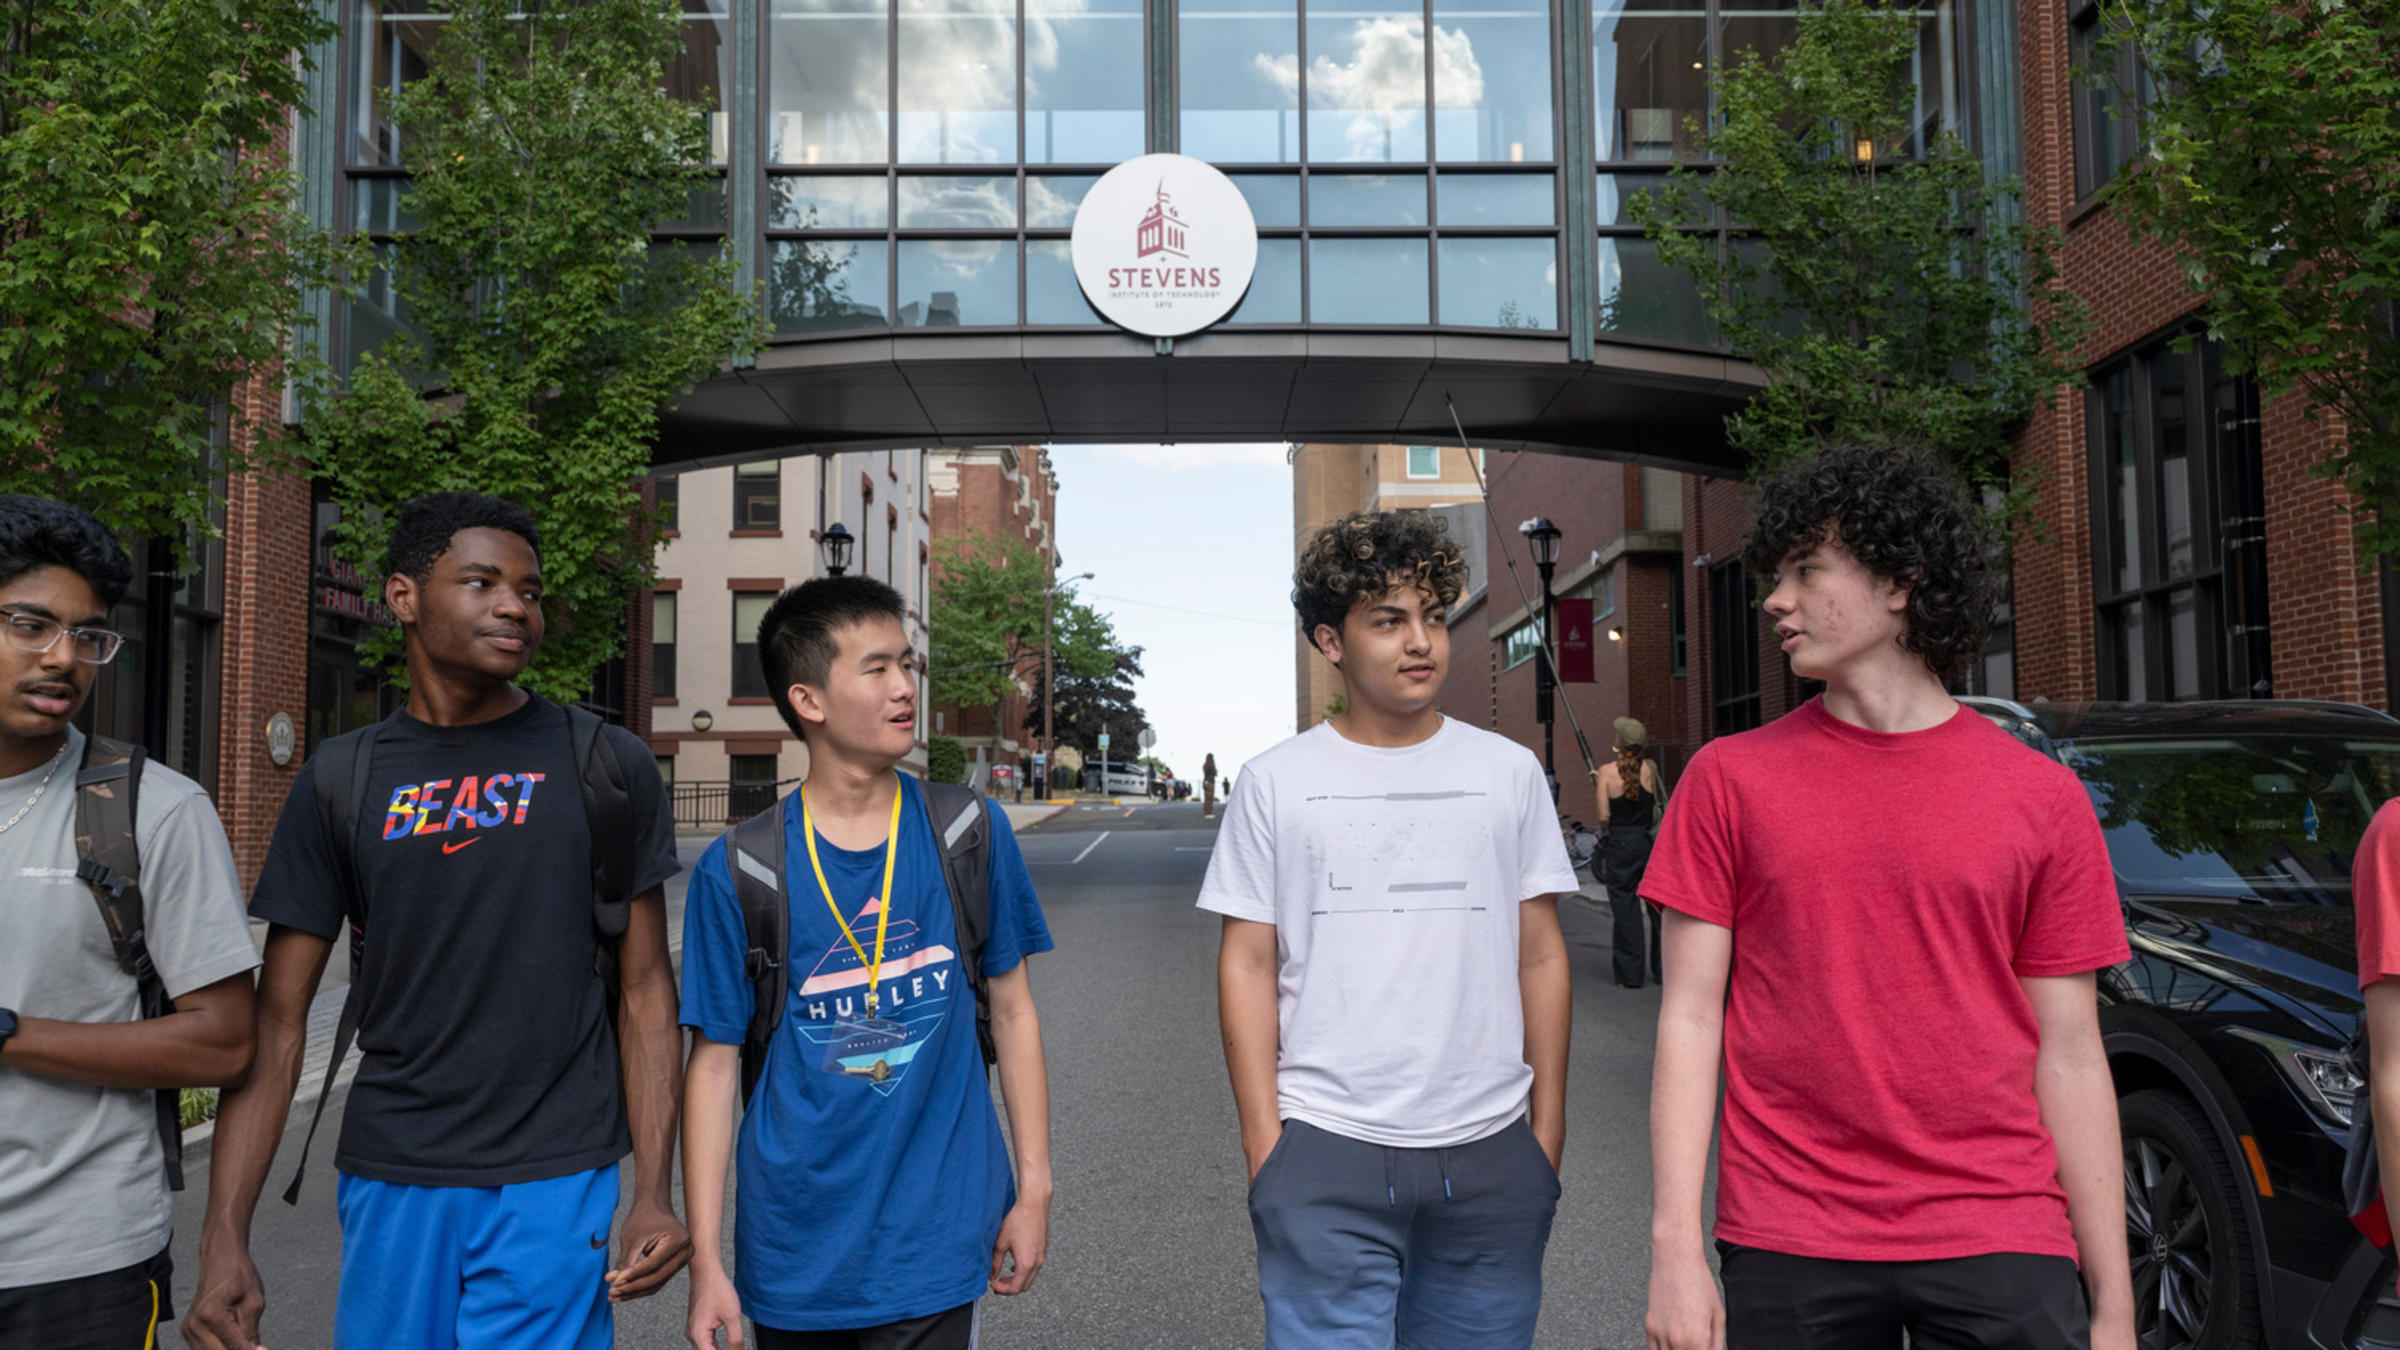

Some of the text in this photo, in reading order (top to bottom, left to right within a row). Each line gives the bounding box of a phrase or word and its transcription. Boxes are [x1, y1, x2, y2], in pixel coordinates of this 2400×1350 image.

[1108, 267, 1221, 289] STEVENS
[323, 586, 368, 617] FAMILY
[383, 772, 546, 840] BEAST
[808, 969, 949, 1020] HURLEY
